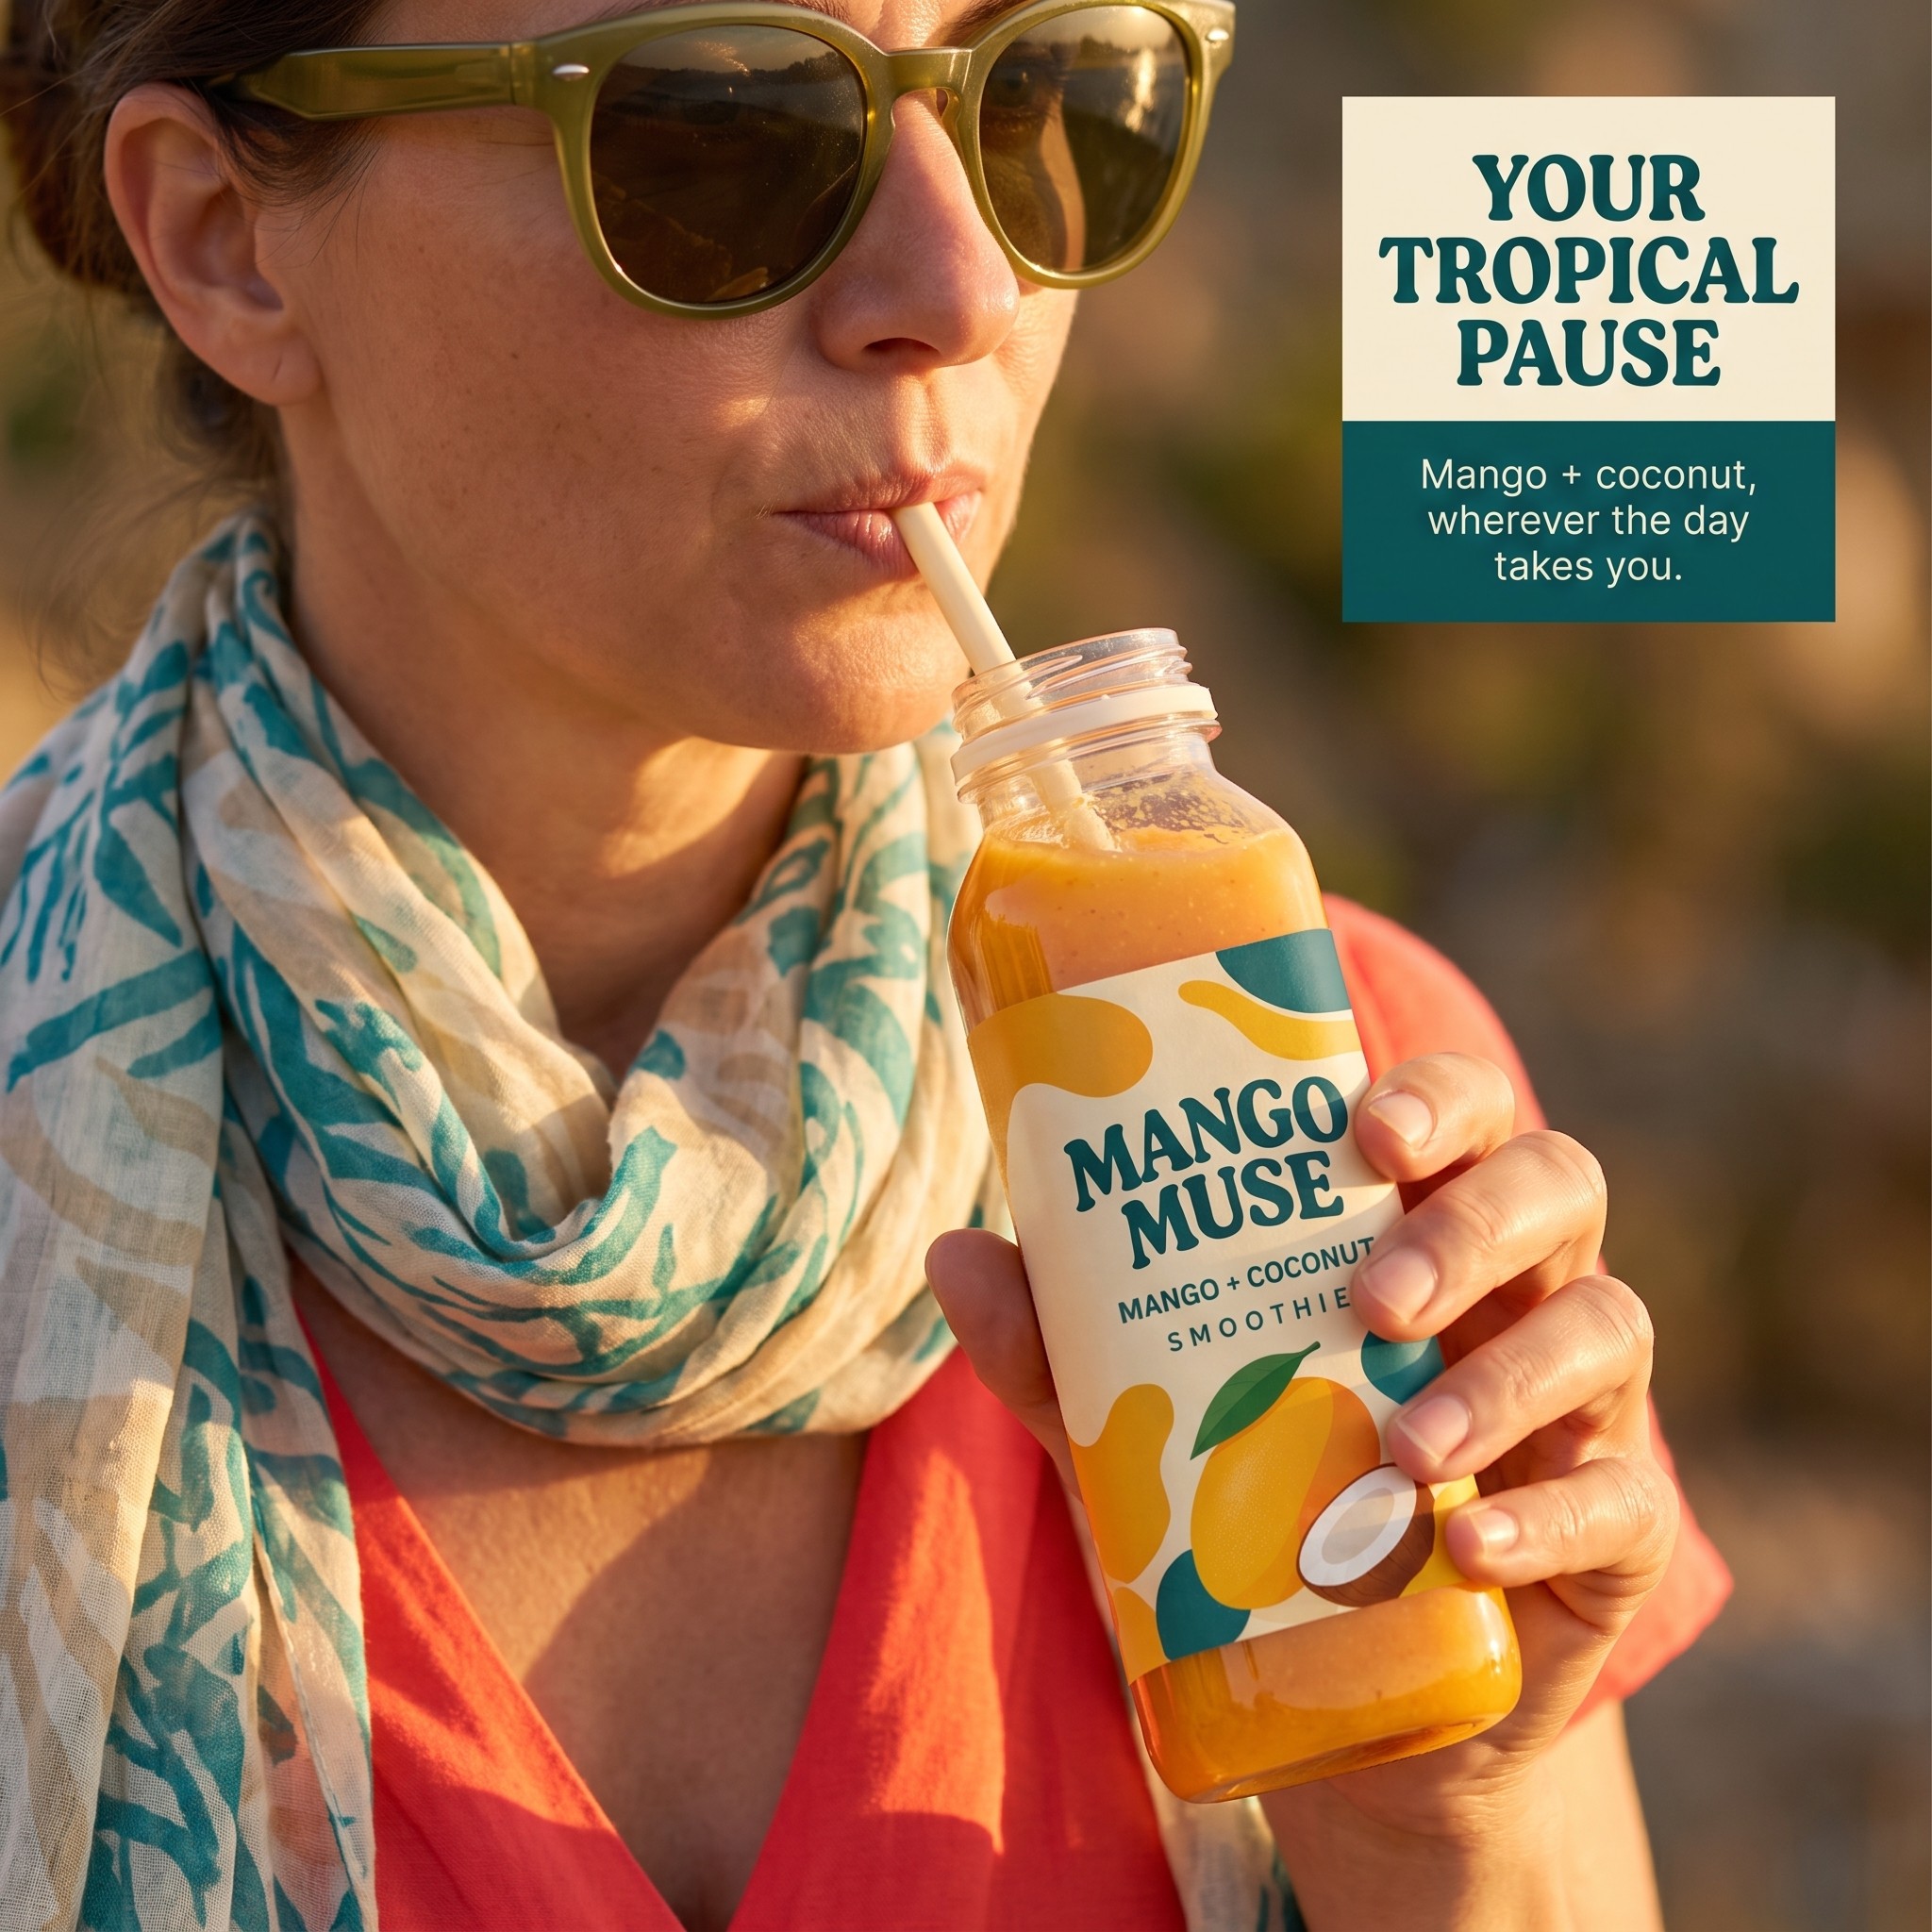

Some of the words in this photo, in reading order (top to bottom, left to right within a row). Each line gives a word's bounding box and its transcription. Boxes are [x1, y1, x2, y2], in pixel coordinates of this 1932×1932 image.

[1063, 1075, 1349, 1213] MANGO
[1121, 1150, 1344, 1270] MUSE
[1117, 1277, 1220, 1324] MANGO
[1226, 1276, 1241, 1291] +
[1246, 1236, 1374, 1289] COCONUT
[1167, 1287, 1351, 1353] SMOOTHIE
